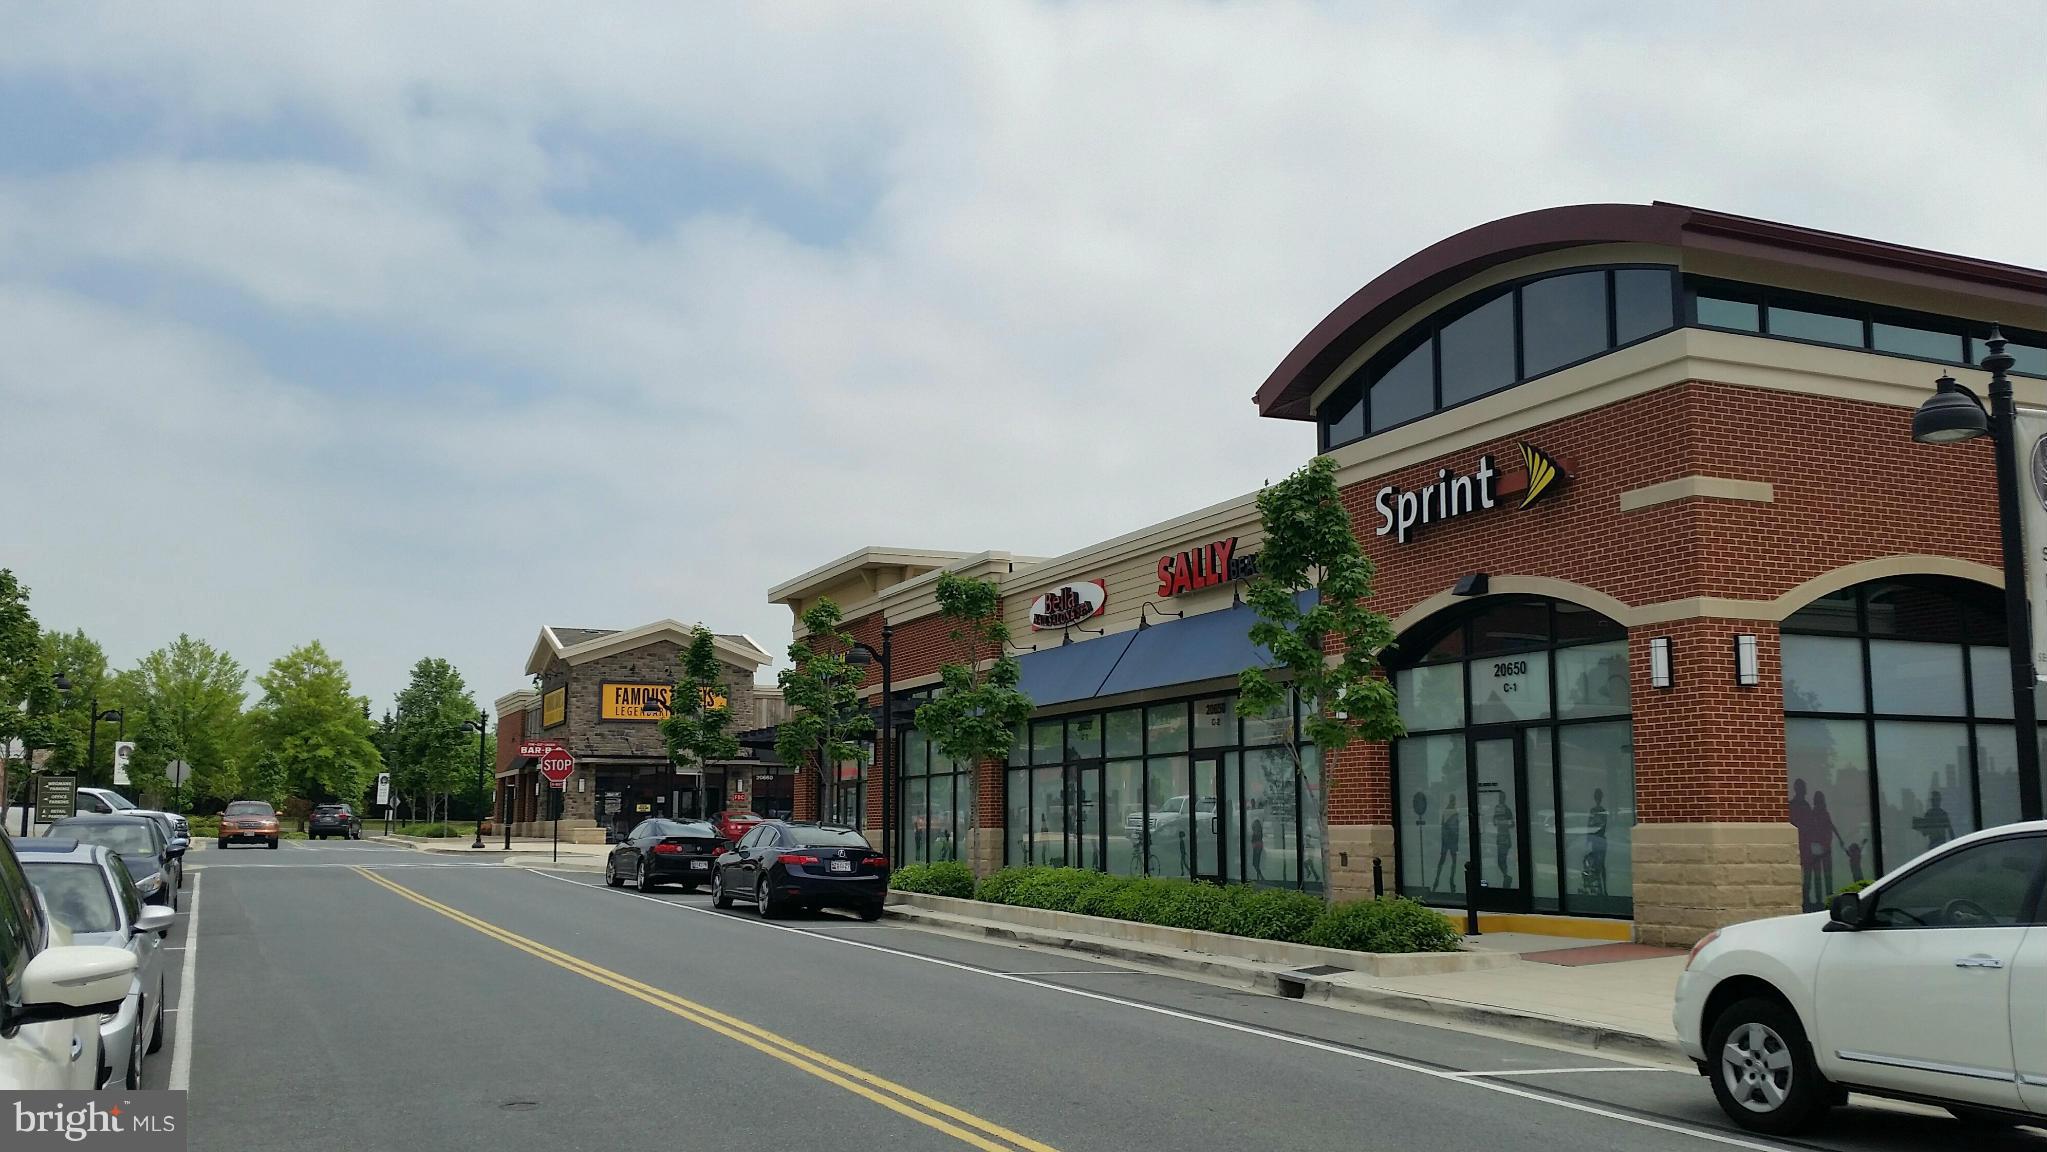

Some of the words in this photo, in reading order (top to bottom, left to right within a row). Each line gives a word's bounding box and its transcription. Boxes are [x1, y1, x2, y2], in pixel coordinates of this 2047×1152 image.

[1375, 455, 1495, 544] Sprint
[1158, 537, 1238, 597] SALLY
[1045, 587, 1079, 614] Bella
[1493, 661, 1526, 677] 20650
[1503, 683, 1517, 693] C-1
[615, 687, 668, 706] FAMOUS
[615, 706, 669, 717] LEGENR
[520, 746, 562, 754] BAR-B
[543, 759, 572, 771] STOP
